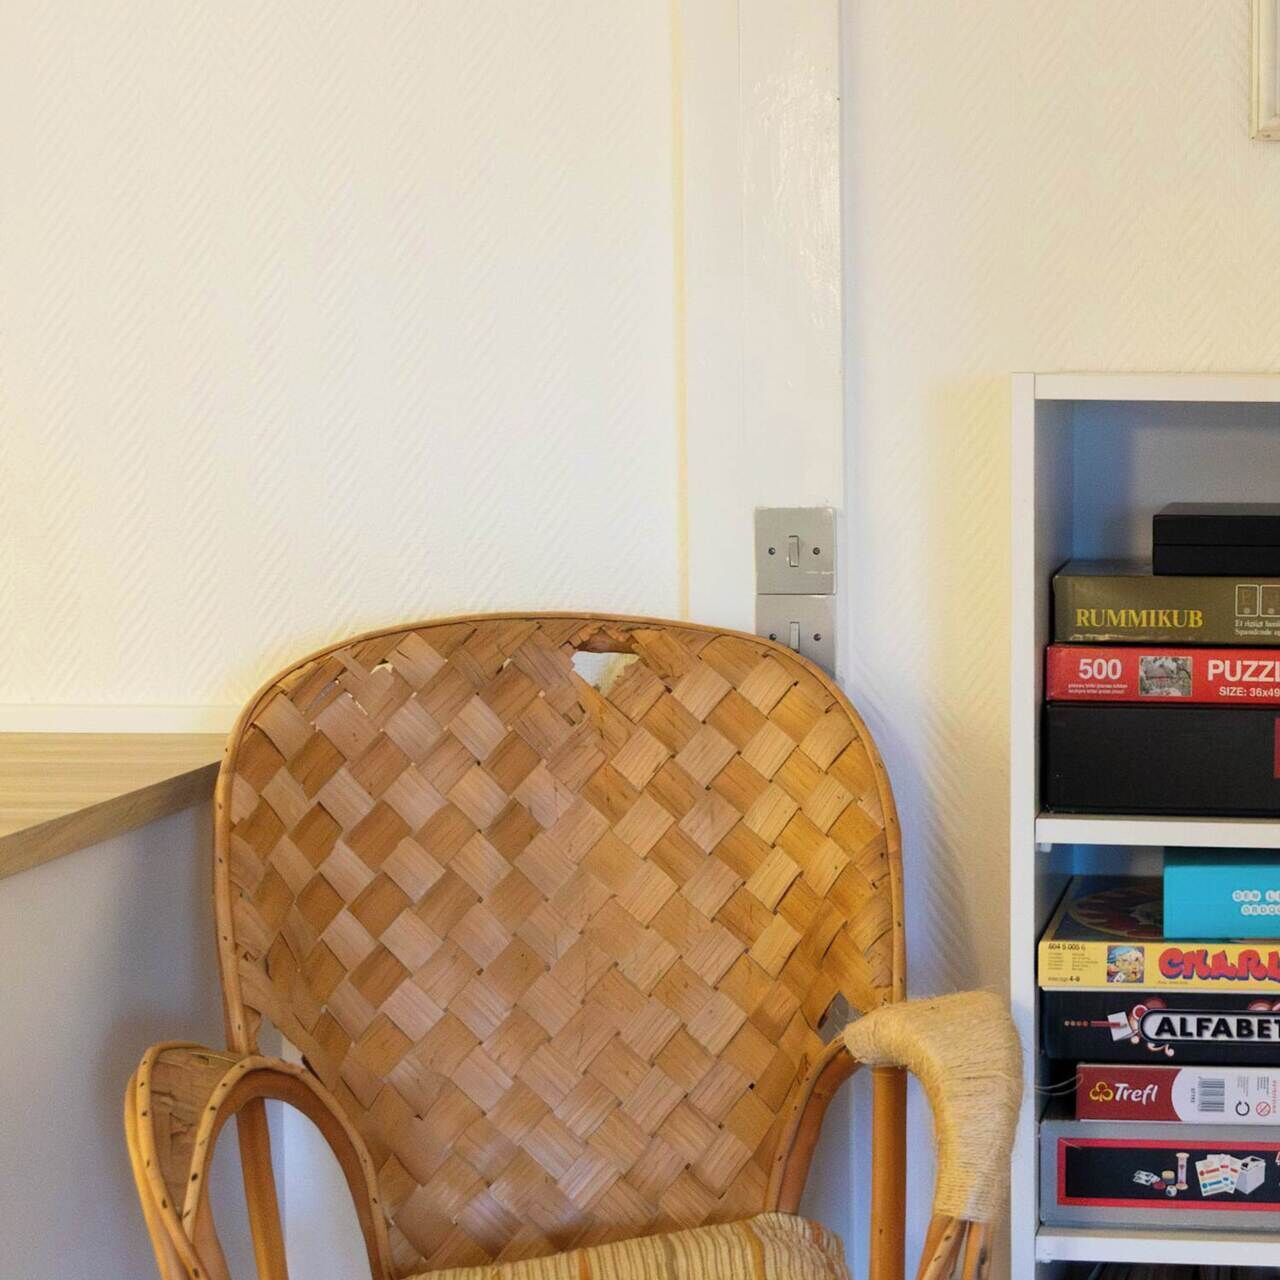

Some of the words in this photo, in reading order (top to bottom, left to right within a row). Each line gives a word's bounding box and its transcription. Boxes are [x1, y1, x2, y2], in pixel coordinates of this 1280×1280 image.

[1075, 608, 1204, 628] RUMMIKUB
[1078, 658, 1122, 680] 500
[1218, 686, 1247, 697] SIZE:
[1114, 1082, 1159, 1106] Trefl
